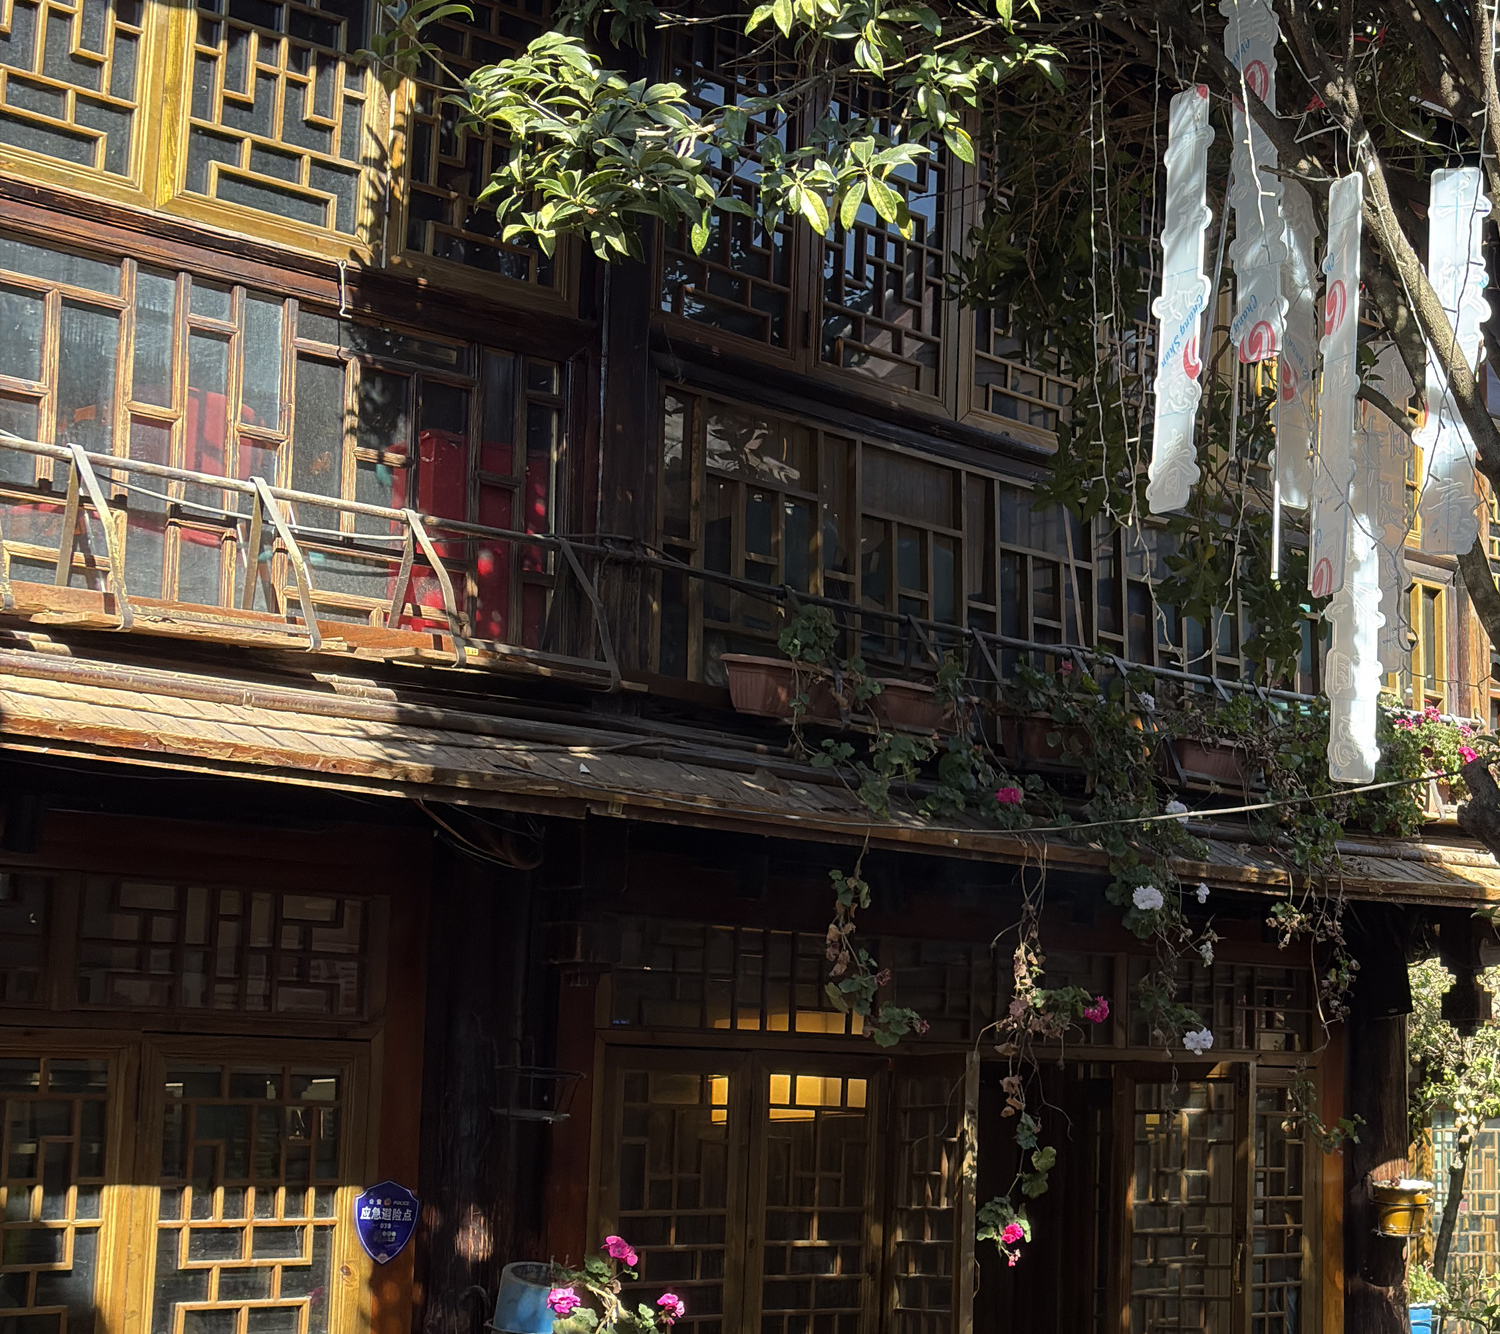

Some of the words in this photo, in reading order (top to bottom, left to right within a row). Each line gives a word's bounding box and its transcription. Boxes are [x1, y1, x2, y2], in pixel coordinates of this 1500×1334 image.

[360, 1206, 412, 1222] 应急避险点
